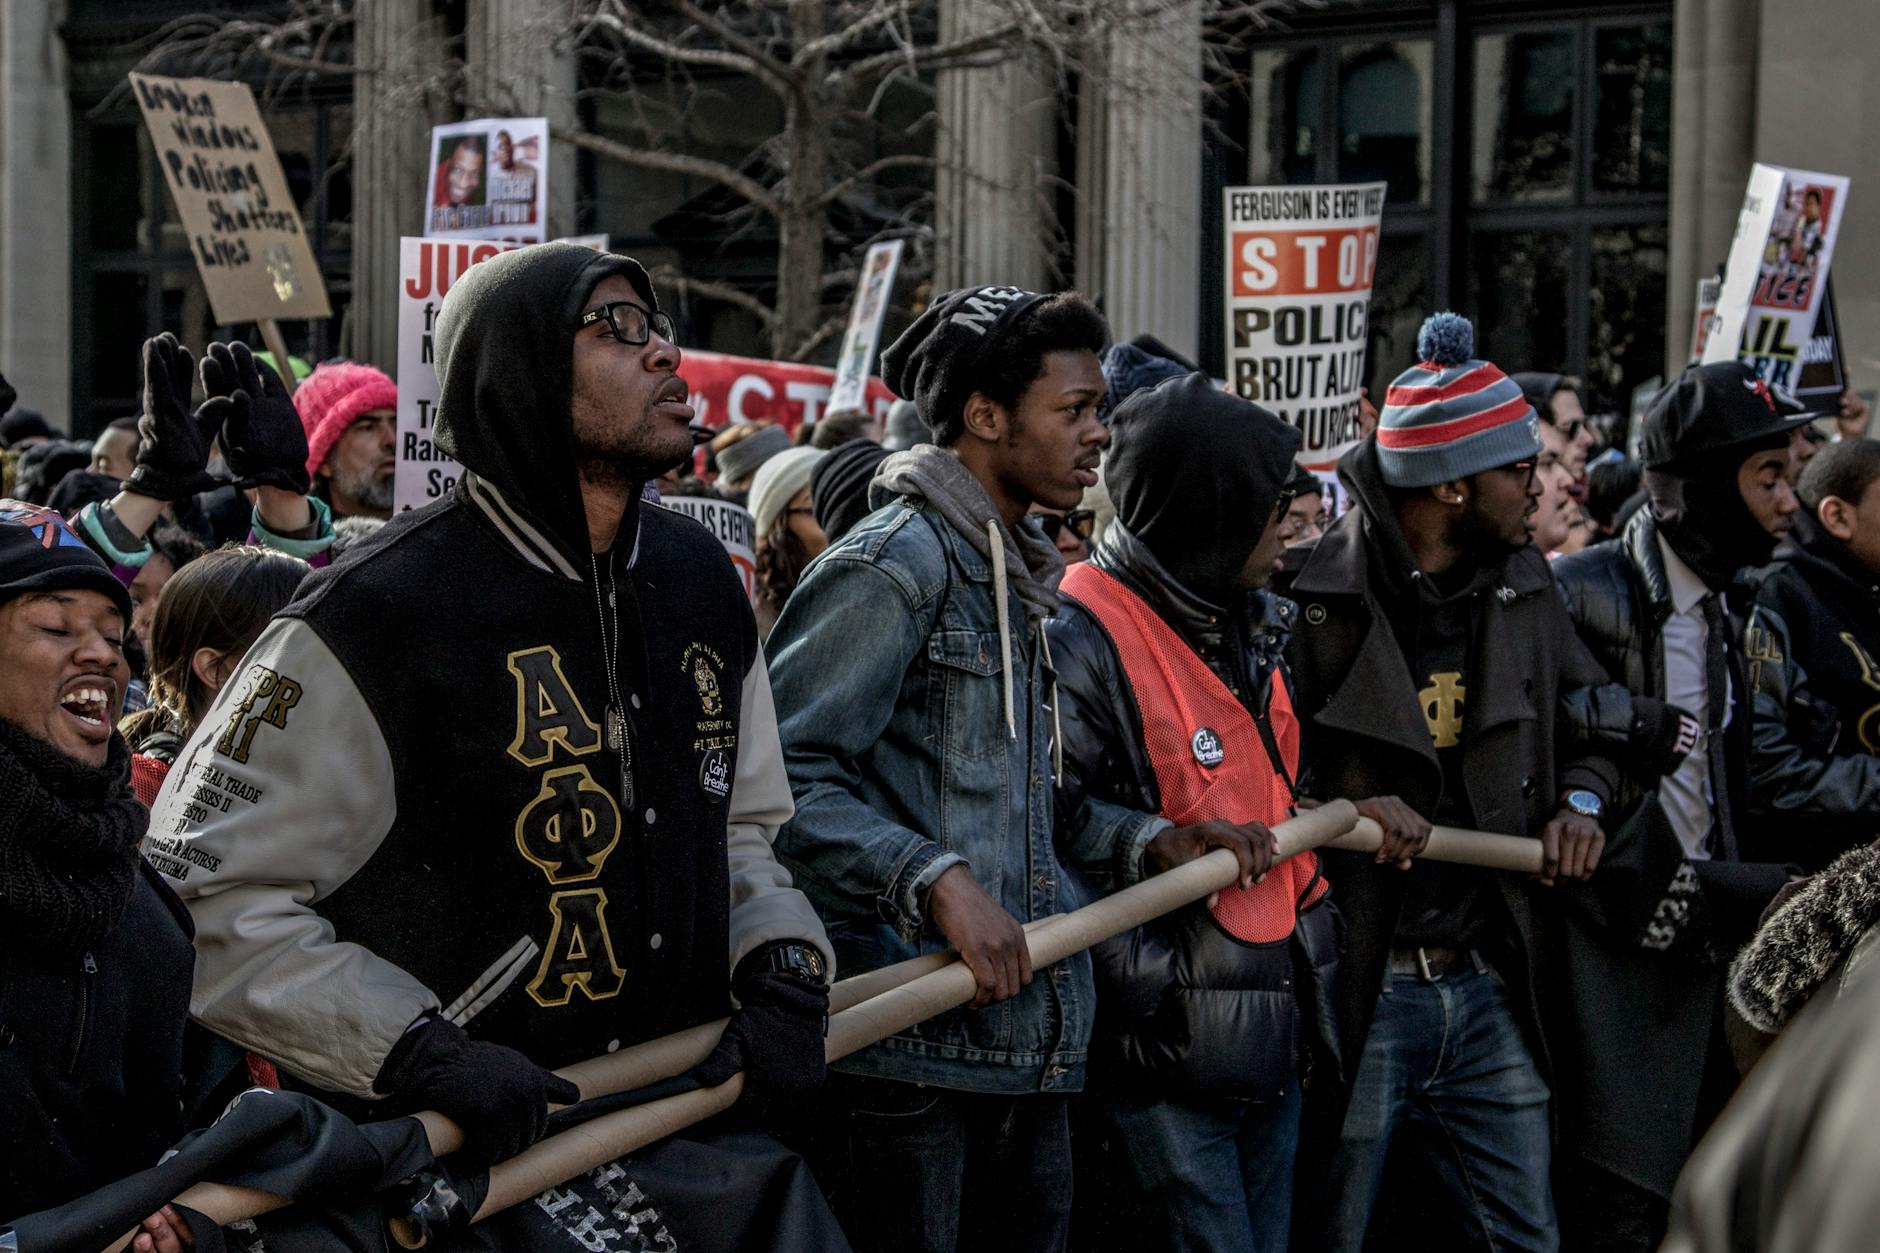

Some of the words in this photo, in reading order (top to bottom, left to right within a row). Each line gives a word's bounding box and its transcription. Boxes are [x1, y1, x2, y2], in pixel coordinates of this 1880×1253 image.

[171, 117, 260, 151] Windows
[164, 149, 269, 209] Policing
[206, 198, 298, 235] Shatters
[1231, 190, 1312, 221] FERGUSON
[1316, 189, 1330, 219] IS
[196, 235, 250, 269] Lives
[1242, 232, 1376, 290] STOP
[717, 751, 724, 766] I
